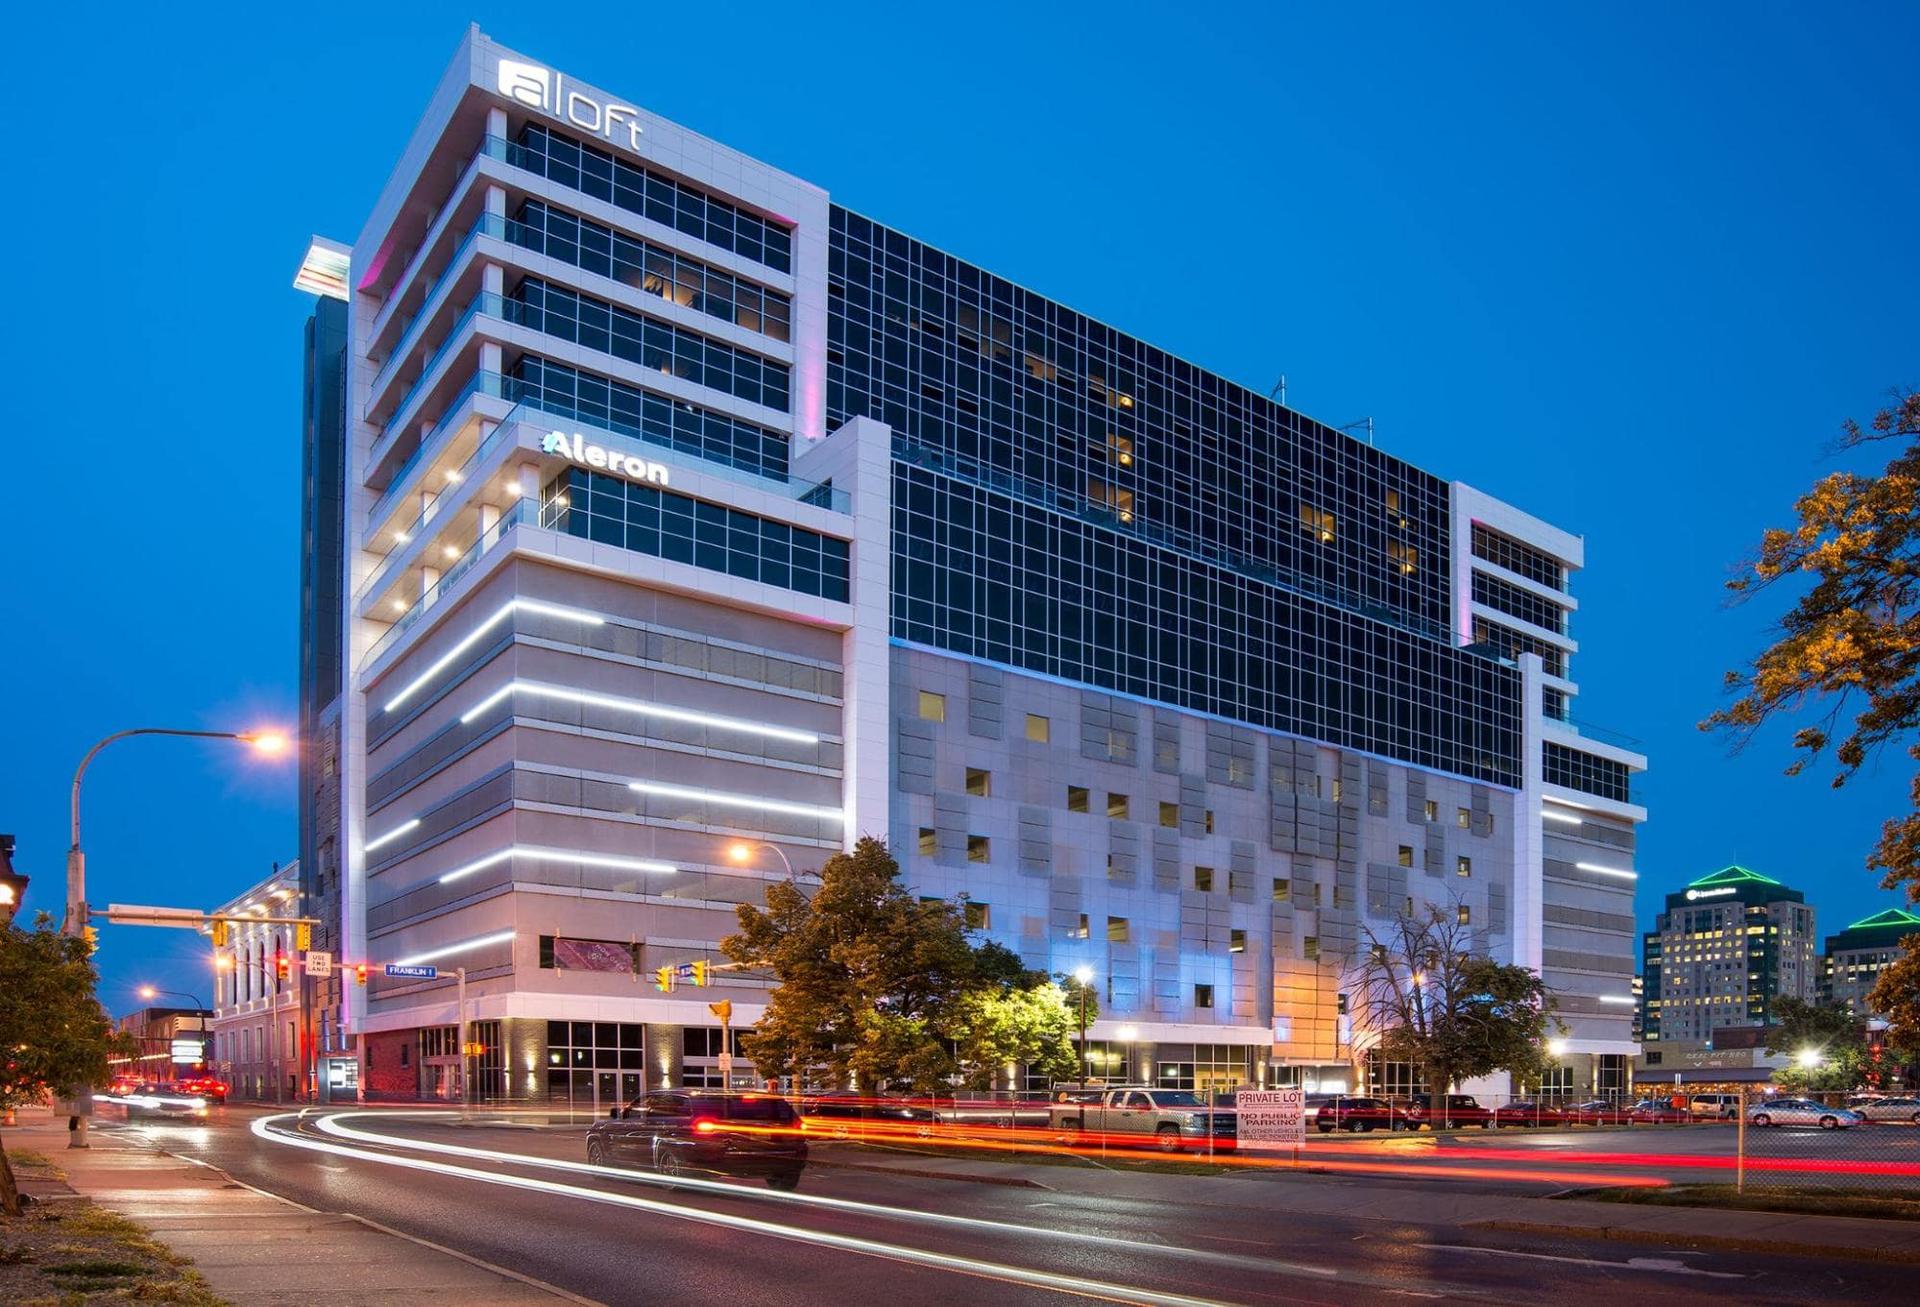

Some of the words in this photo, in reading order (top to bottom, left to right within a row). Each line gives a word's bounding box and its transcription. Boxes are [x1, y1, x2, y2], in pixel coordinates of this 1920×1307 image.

[541, 430, 669, 486] Aleron
[389, 966, 427, 976] FRANKLIN
[1239, 1093, 1280, 1103] PRIVATE
[1283, 1092, 1302, 1103] LOT
